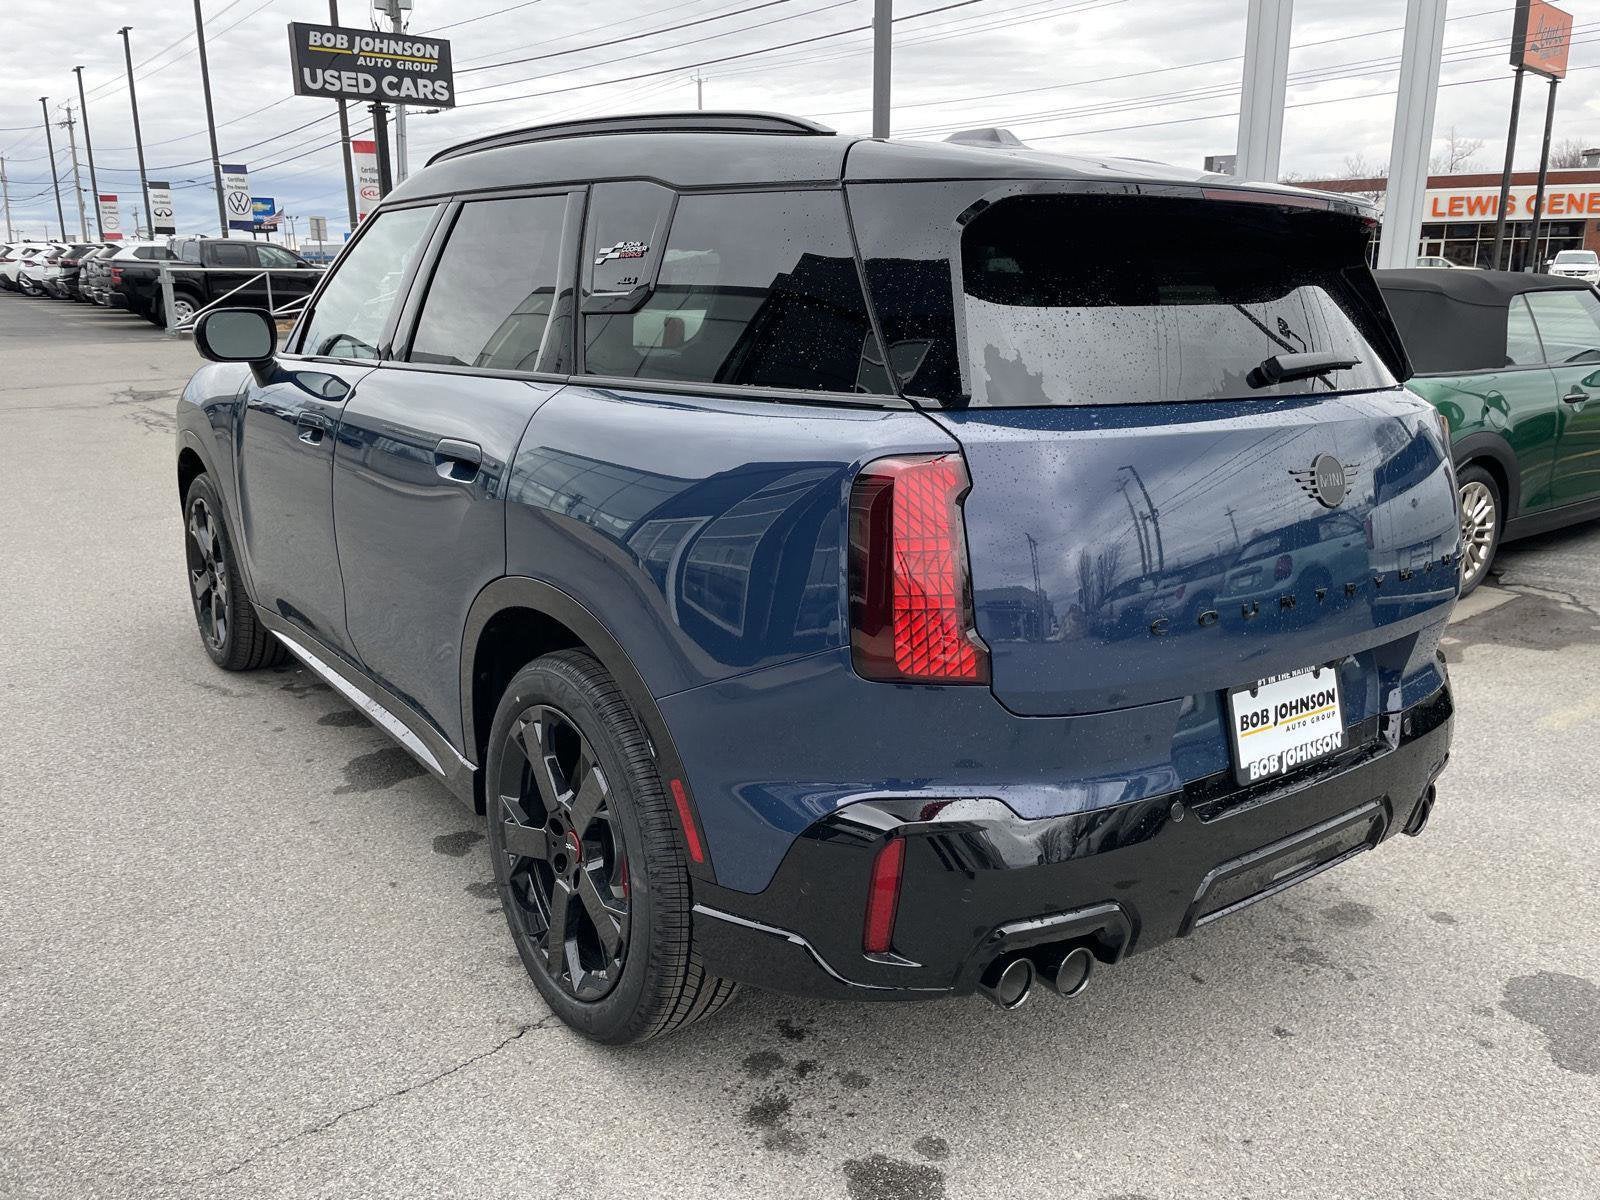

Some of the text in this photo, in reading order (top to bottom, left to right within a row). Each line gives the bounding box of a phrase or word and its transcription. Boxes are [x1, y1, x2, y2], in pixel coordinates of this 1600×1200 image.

[308, 31, 440, 59] BOB JOHNSON
[357, 57, 438, 72] AUTO GROUP
[303, 67, 450, 101] USED CARS
[1431, 192, 1600, 217] LEWIS GENE
[1319, 472, 1343, 488] MINI
[1150, 553, 1451, 637] COUNTRYMAN
[1240, 688, 1336, 732] BOB JOHNSON
[1285, 711, 1336, 733] AUTO GROUP
[1249, 732, 1343, 781] BOB JOHNSON
